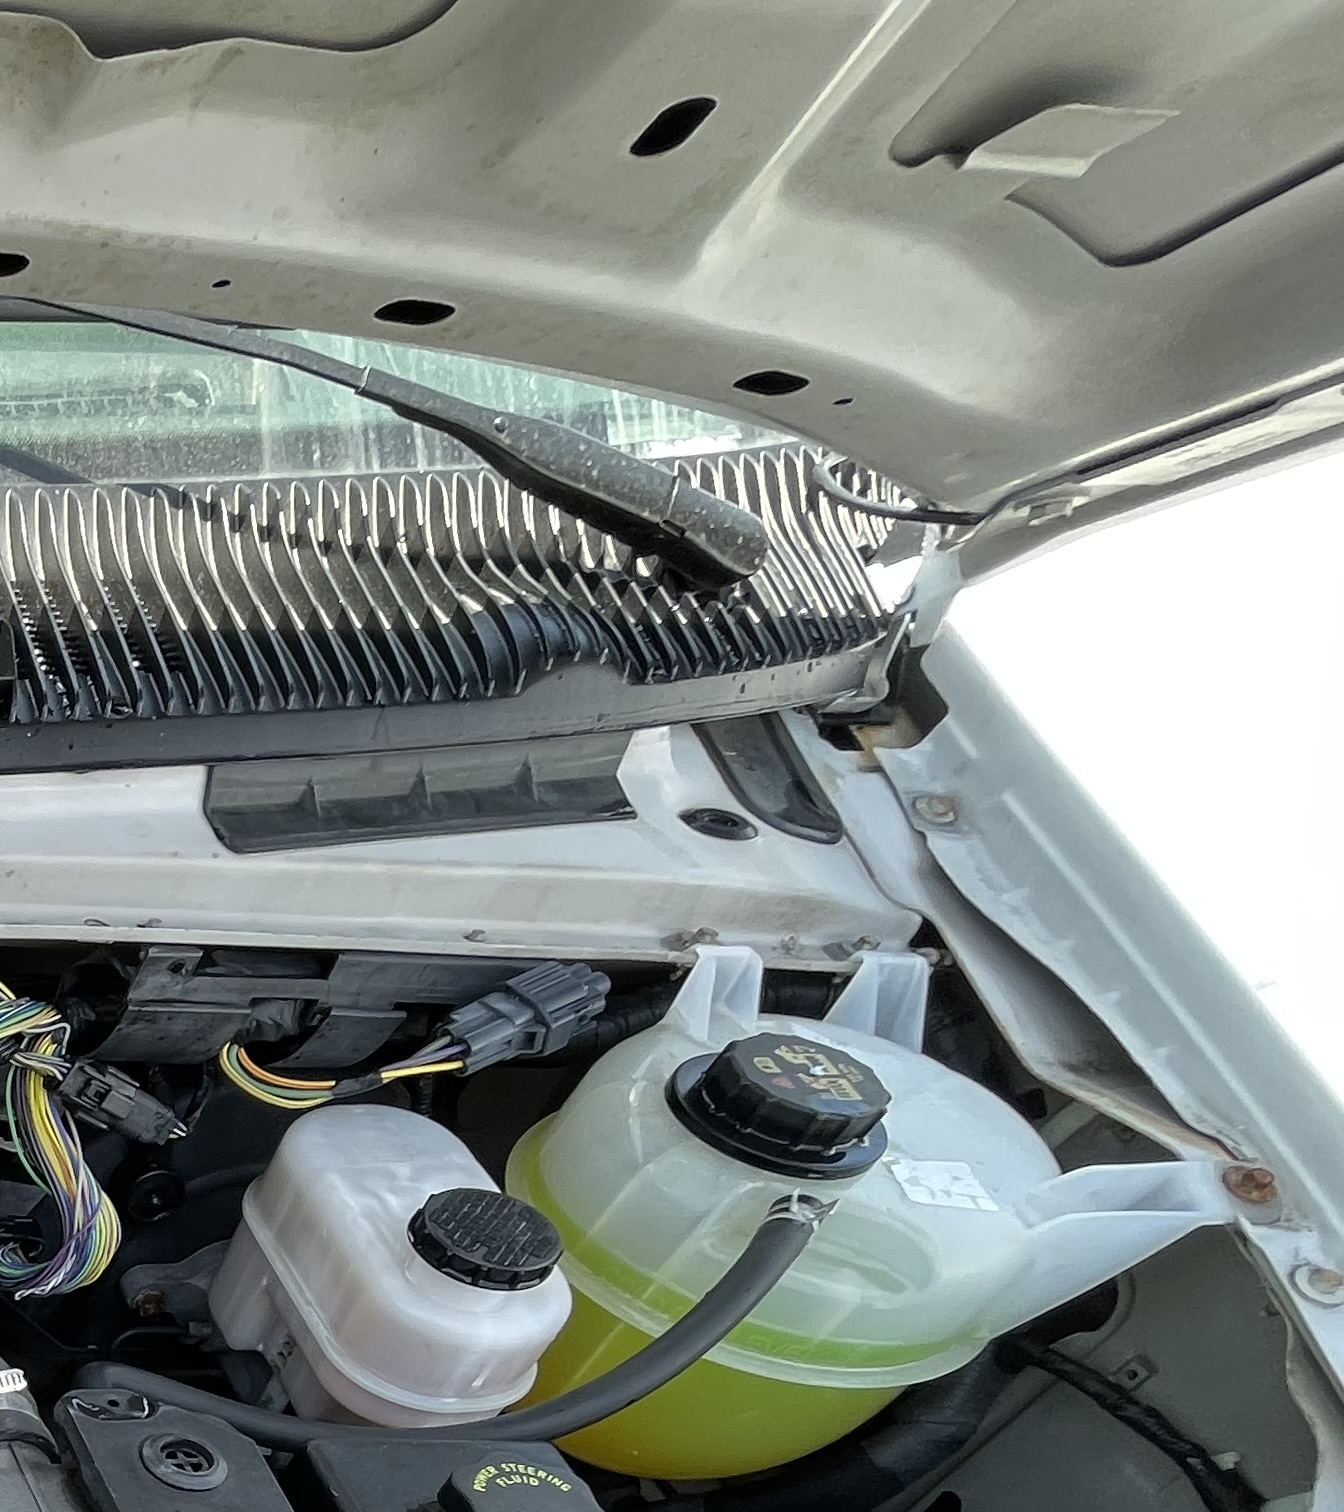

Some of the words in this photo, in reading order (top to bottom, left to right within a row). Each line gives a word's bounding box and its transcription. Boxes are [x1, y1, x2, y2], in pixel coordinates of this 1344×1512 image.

[472, 1465, 500, 1492] POWER
[500, 1463, 572, 1492] STEERING
[495, 1474, 540, 1488] FLUID
